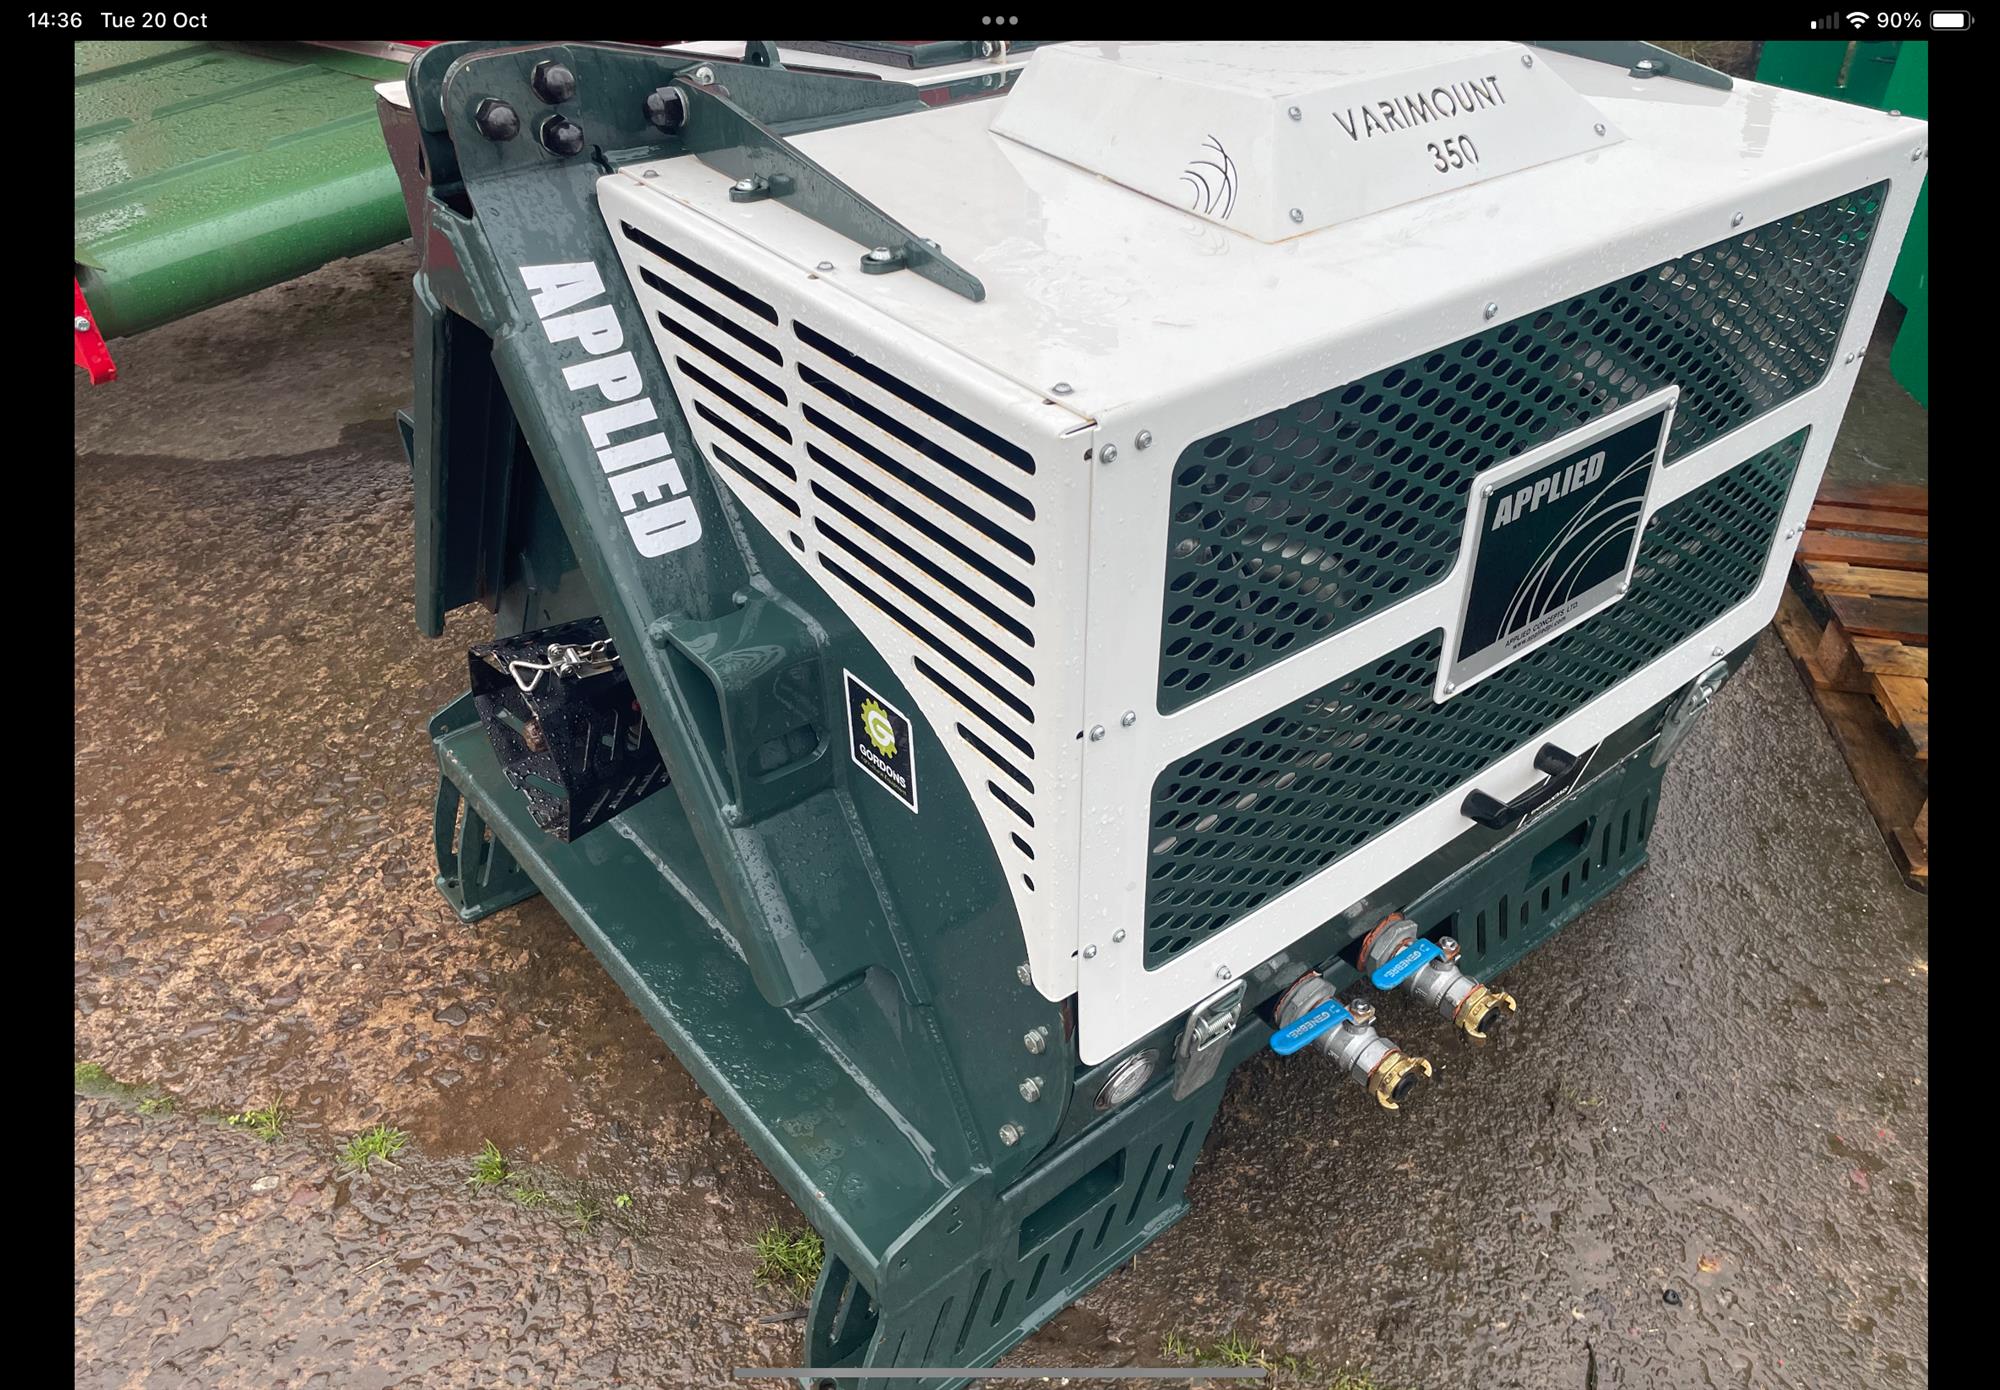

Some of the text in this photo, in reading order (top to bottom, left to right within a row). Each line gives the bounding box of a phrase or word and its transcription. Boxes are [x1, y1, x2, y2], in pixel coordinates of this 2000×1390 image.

[1332, 75, 1506, 141] VARIMOUNT
[1427, 134, 1479, 173] 350
[518, 260, 703, 558] APPLIED
[1491, 450, 1606, 531] APPLIED
[1505, 628, 1532, 647] APPLIED
[860, 743, 907, 789] GORDONS
[1389, 950, 1422, 978] GENEBRE
[1290, 1010, 1331, 1039] GENEBRE
